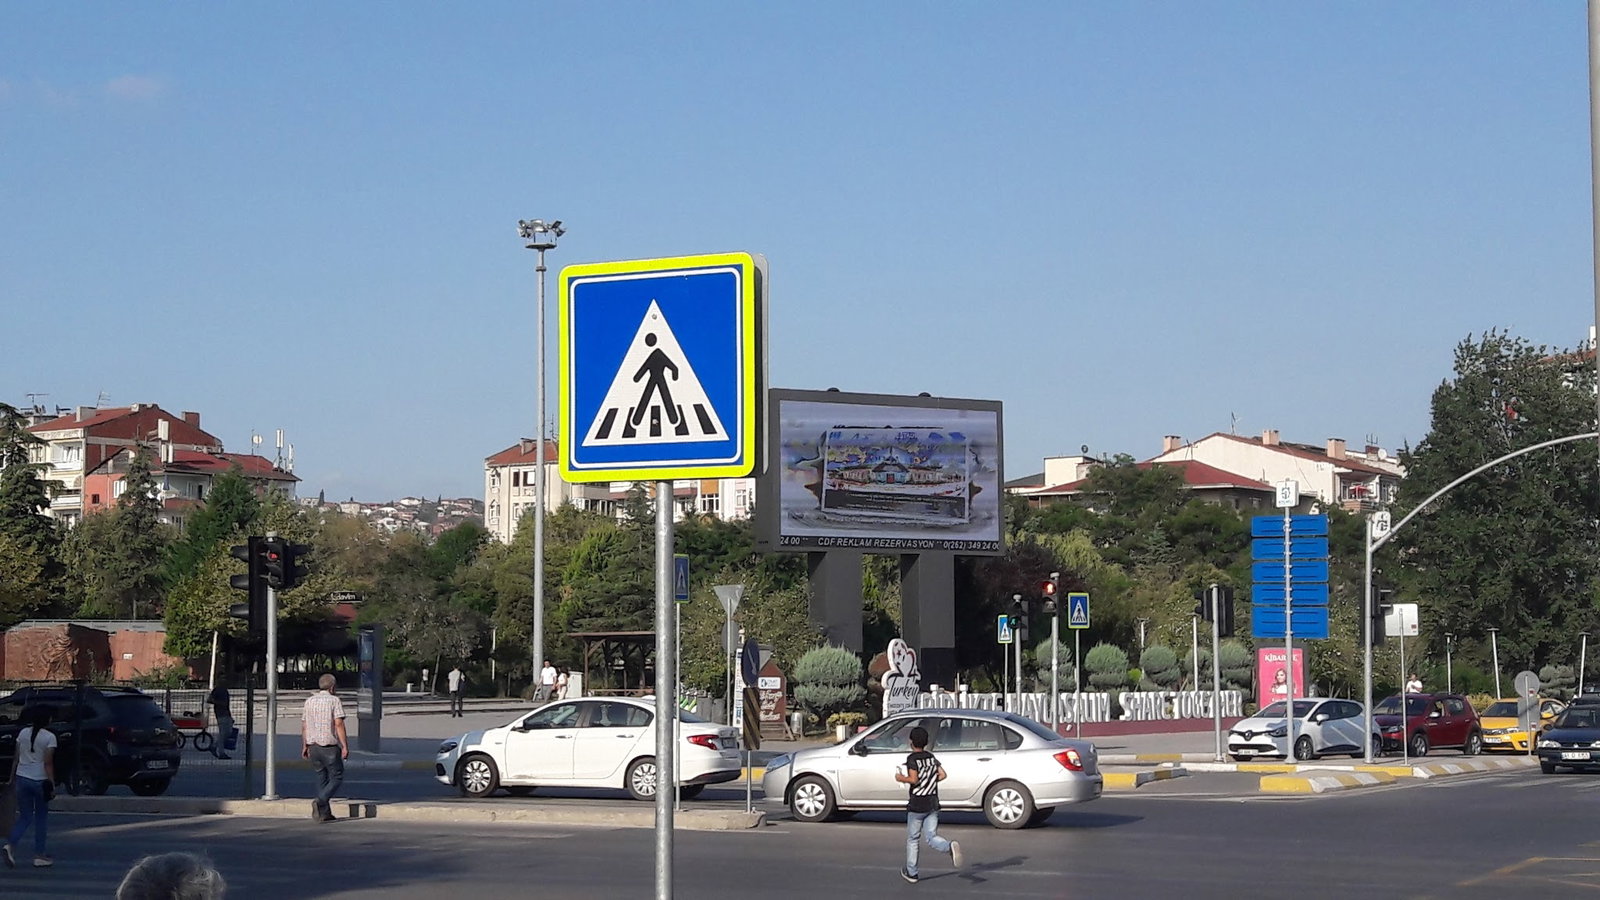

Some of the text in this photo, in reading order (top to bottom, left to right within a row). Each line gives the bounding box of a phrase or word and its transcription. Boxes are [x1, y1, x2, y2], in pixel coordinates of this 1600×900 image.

[780, 536, 789, 545] 24
[790, 536, 801, 545] 00
[818, 537, 836, 546] CDF
[837, 538, 872, 547] REKLAM
[873, 538, 934, 548] REZERVASYON
[968, 541, 981, 550] 349
[982, 541, 991, 550] 24
[889, 678, 919, 708] Turkey
